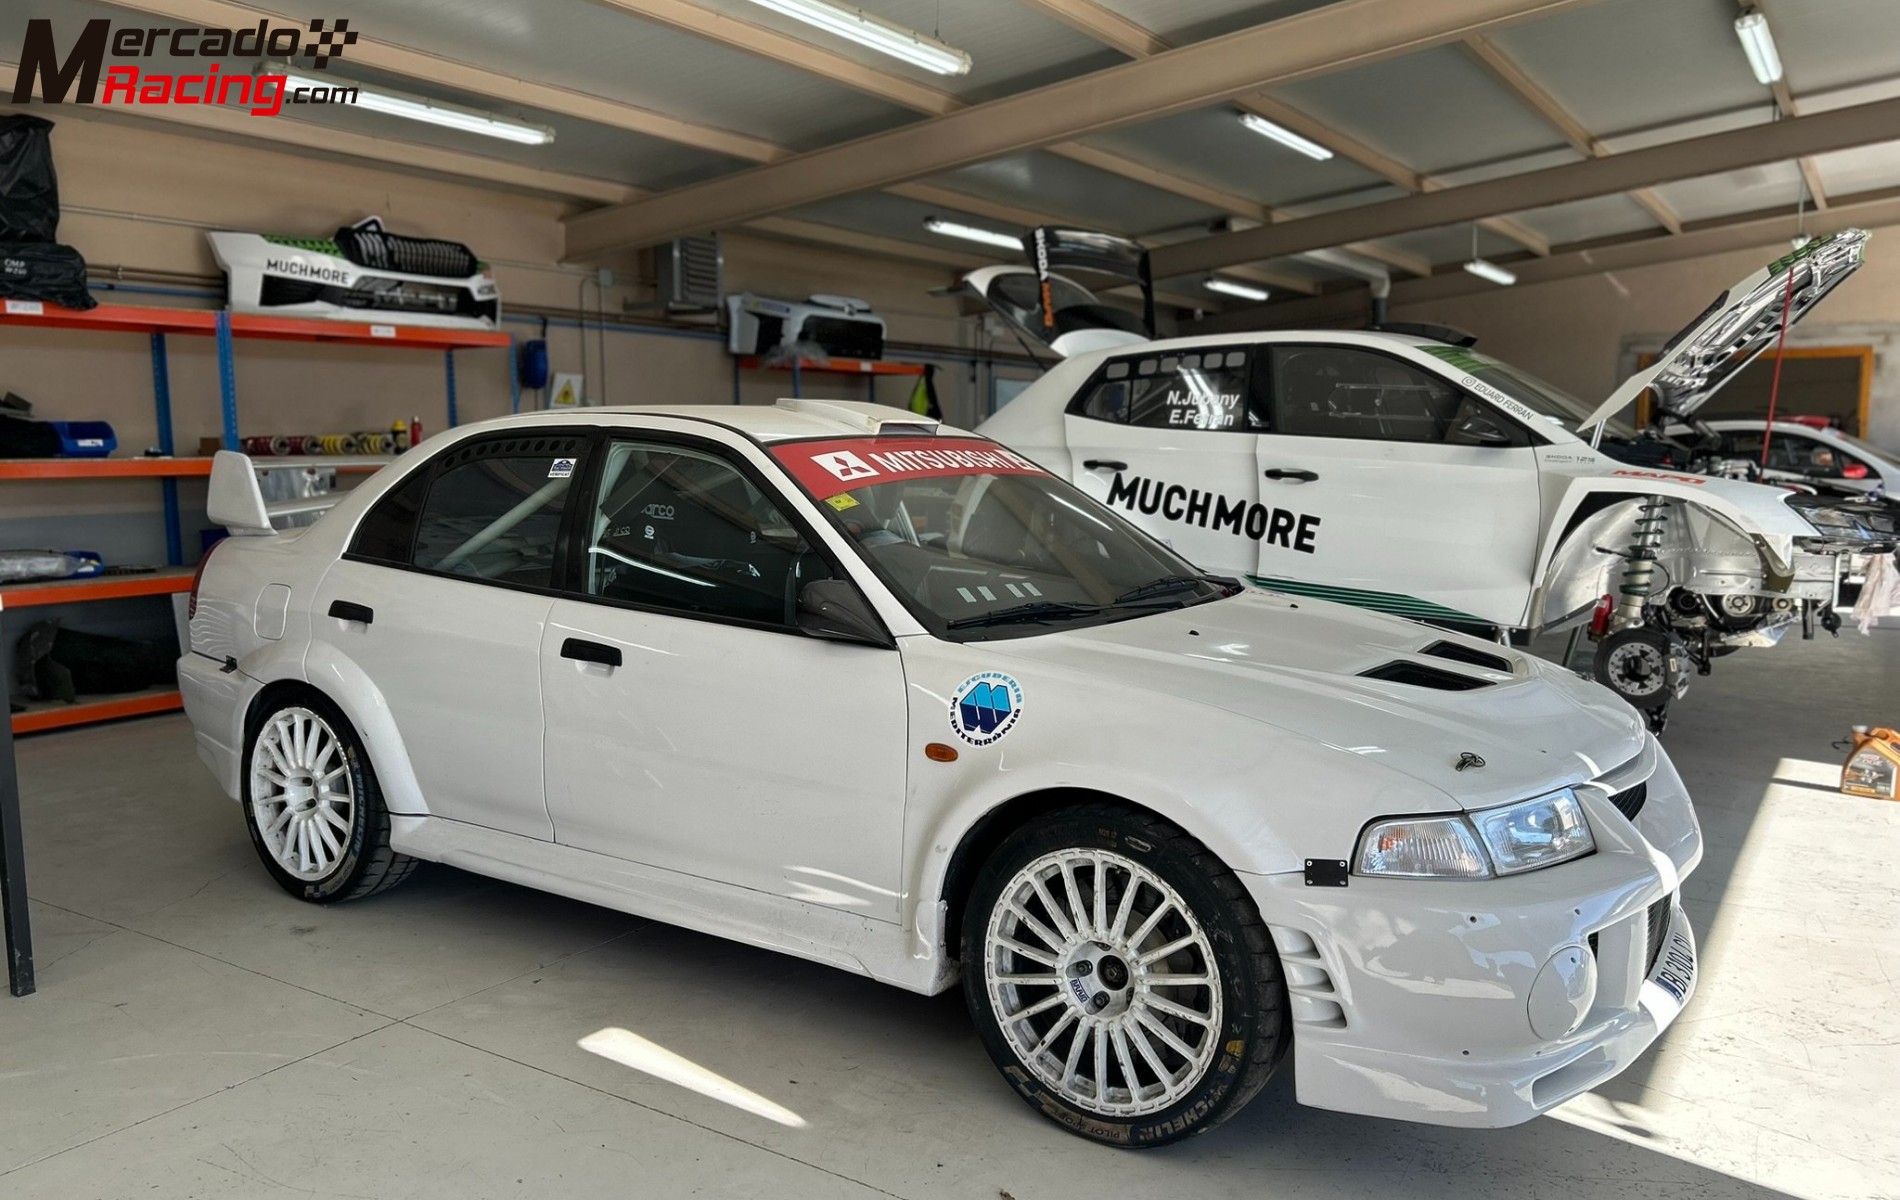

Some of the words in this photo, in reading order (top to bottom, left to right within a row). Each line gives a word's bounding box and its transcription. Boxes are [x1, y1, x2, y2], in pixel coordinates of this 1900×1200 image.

[266, 258, 350, 285] MUCHMORE
[1473, 383, 1505, 403] EDUARD
[1503, 399, 1534, 420] FERRAN
[868, 449, 1016, 474] MITSUBISHI
[1106, 471, 1322, 555] MUCHMORE
[1087, 1126, 1121, 1139] PILOT
